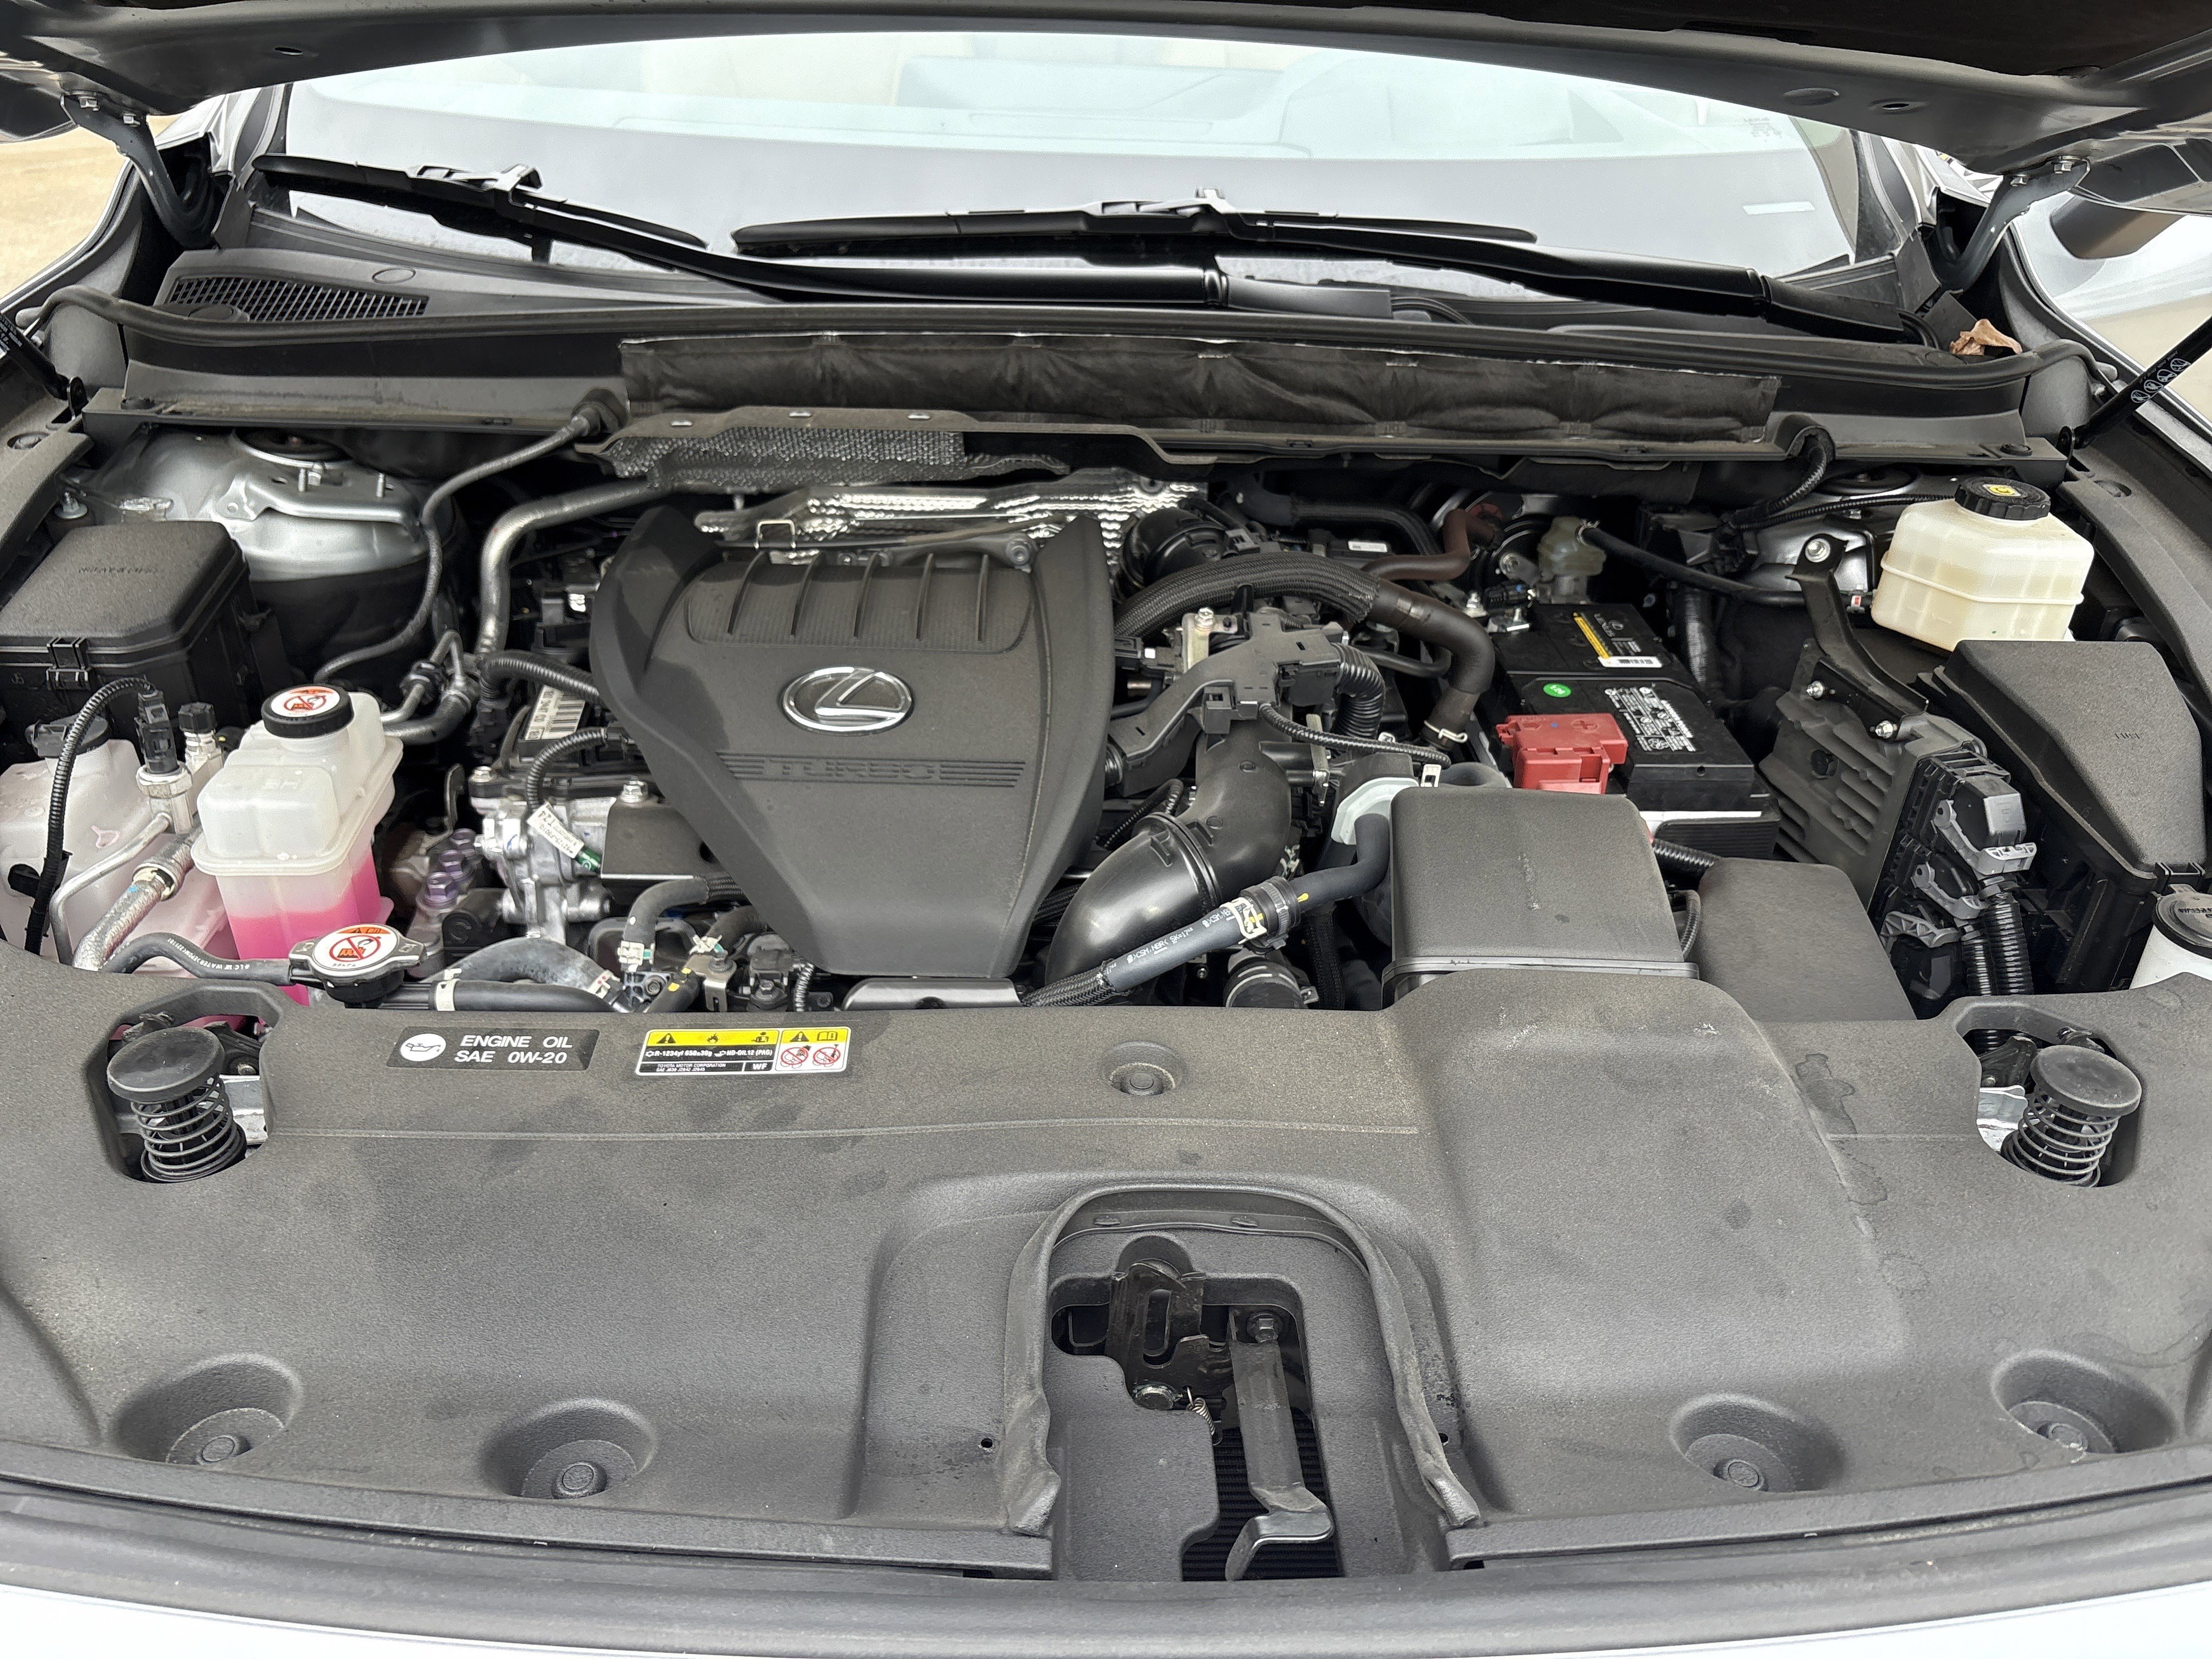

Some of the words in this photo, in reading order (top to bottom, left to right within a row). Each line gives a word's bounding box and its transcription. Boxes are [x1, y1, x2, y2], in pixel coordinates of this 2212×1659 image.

[770, 759, 935, 779] TURBO
[460, 1035, 532, 1048] ENGINE
[543, 1036, 573, 1048] OIL
[454, 1050, 496, 1063] SAE
[507, 1052, 567, 1064] 0W-20
